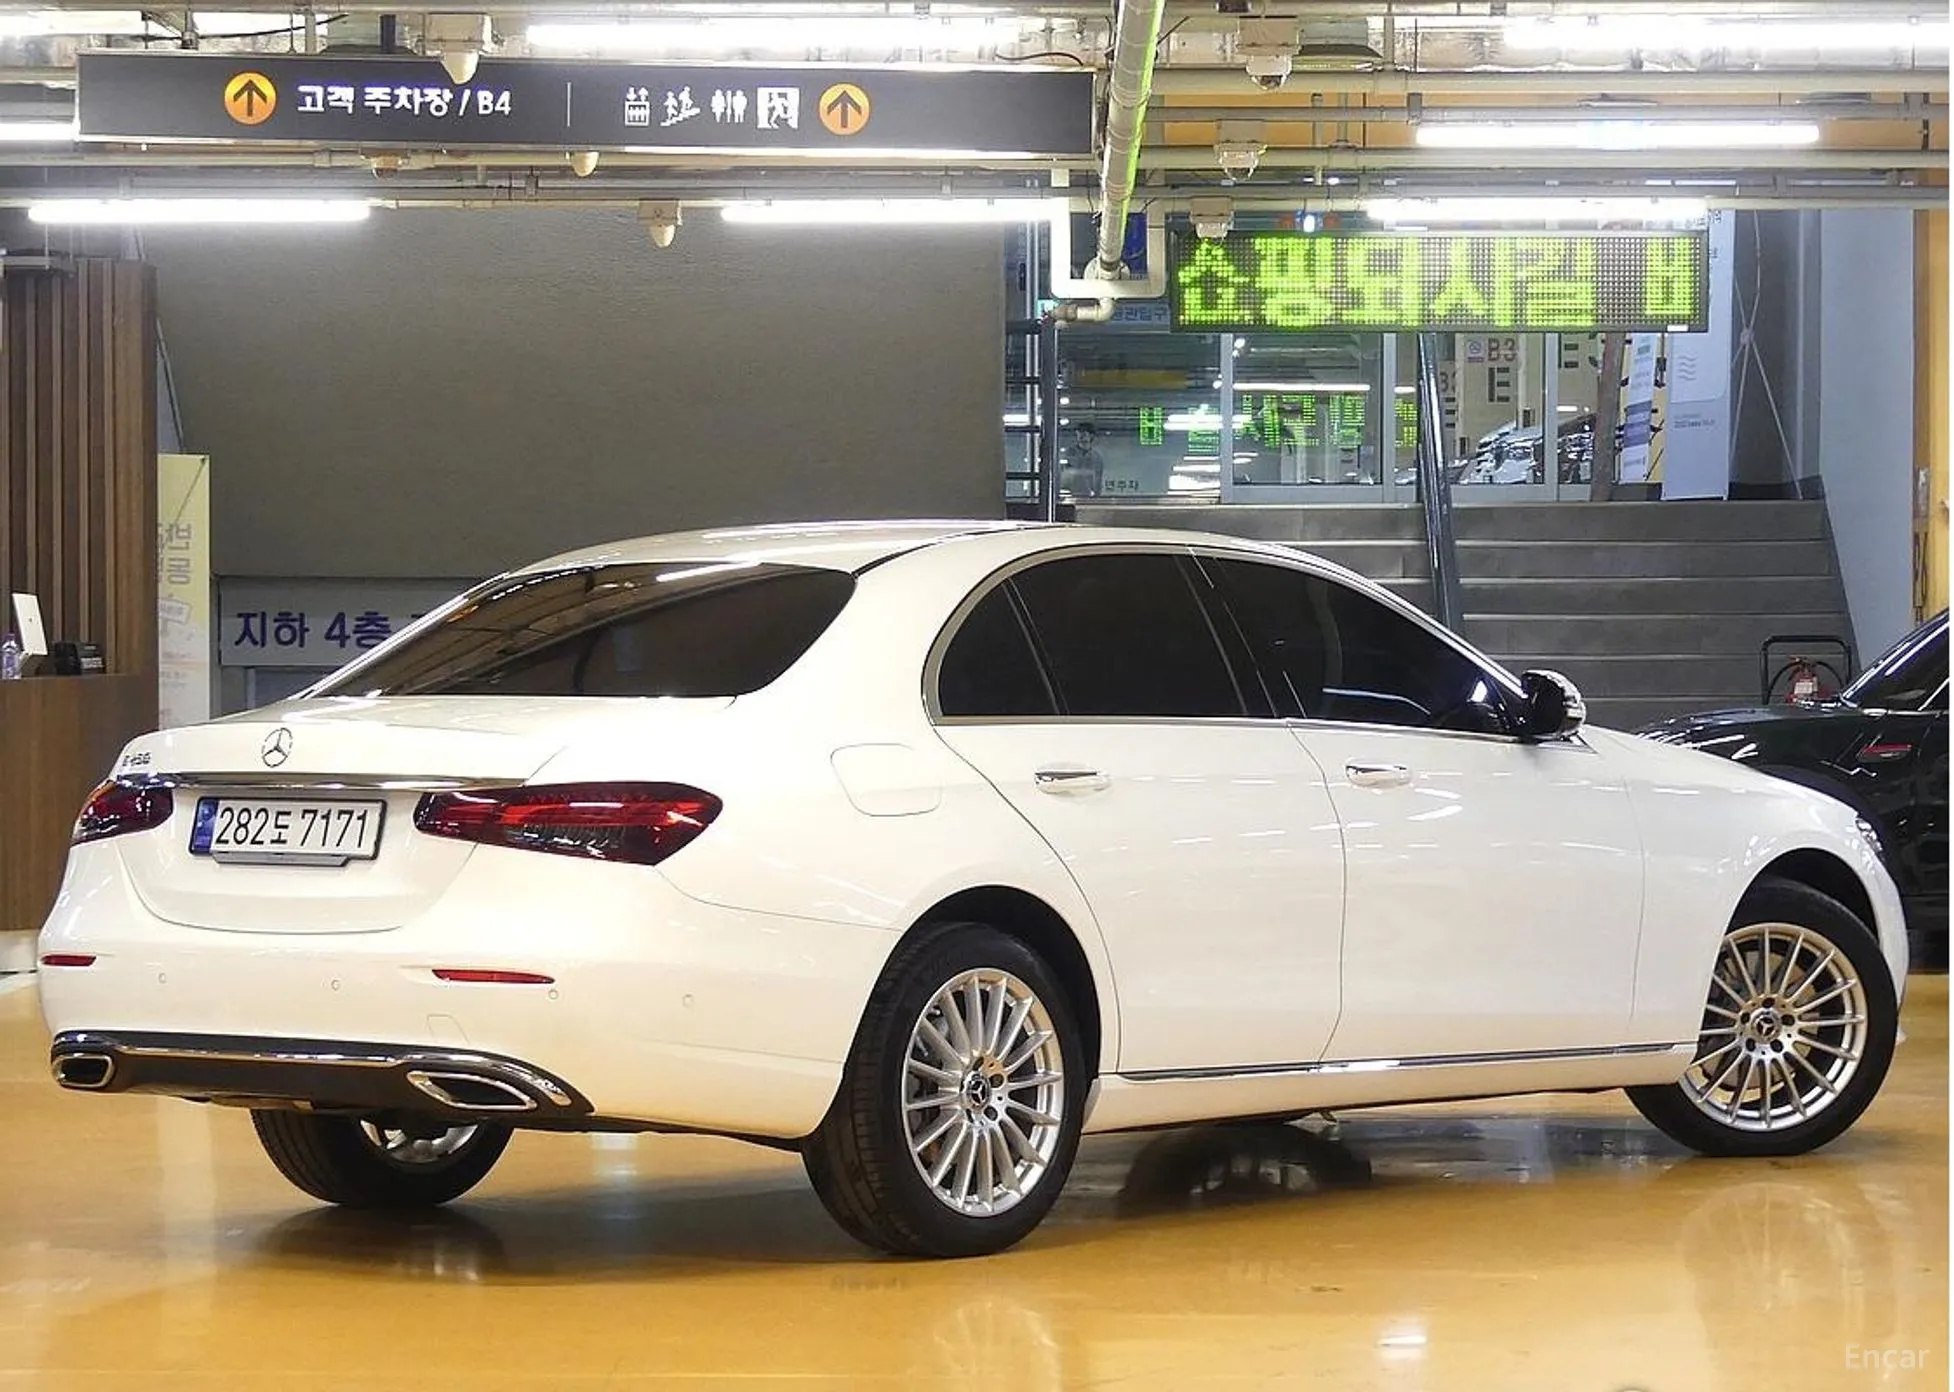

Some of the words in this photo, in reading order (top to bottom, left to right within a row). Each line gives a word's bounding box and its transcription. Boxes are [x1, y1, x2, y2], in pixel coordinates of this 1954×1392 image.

[297, 84, 355, 115] 고객
[364, 86, 453, 117] 주차장
[459, 88, 471, 116] /
[477, 90, 512, 116] B4
[1487, 337, 1517, 362] B3
[233, 611, 310, 649] 지하
[324, 611, 392, 650] 4층
[215, 806, 292, 845] 282도
[299, 808, 368, 849] 7171
